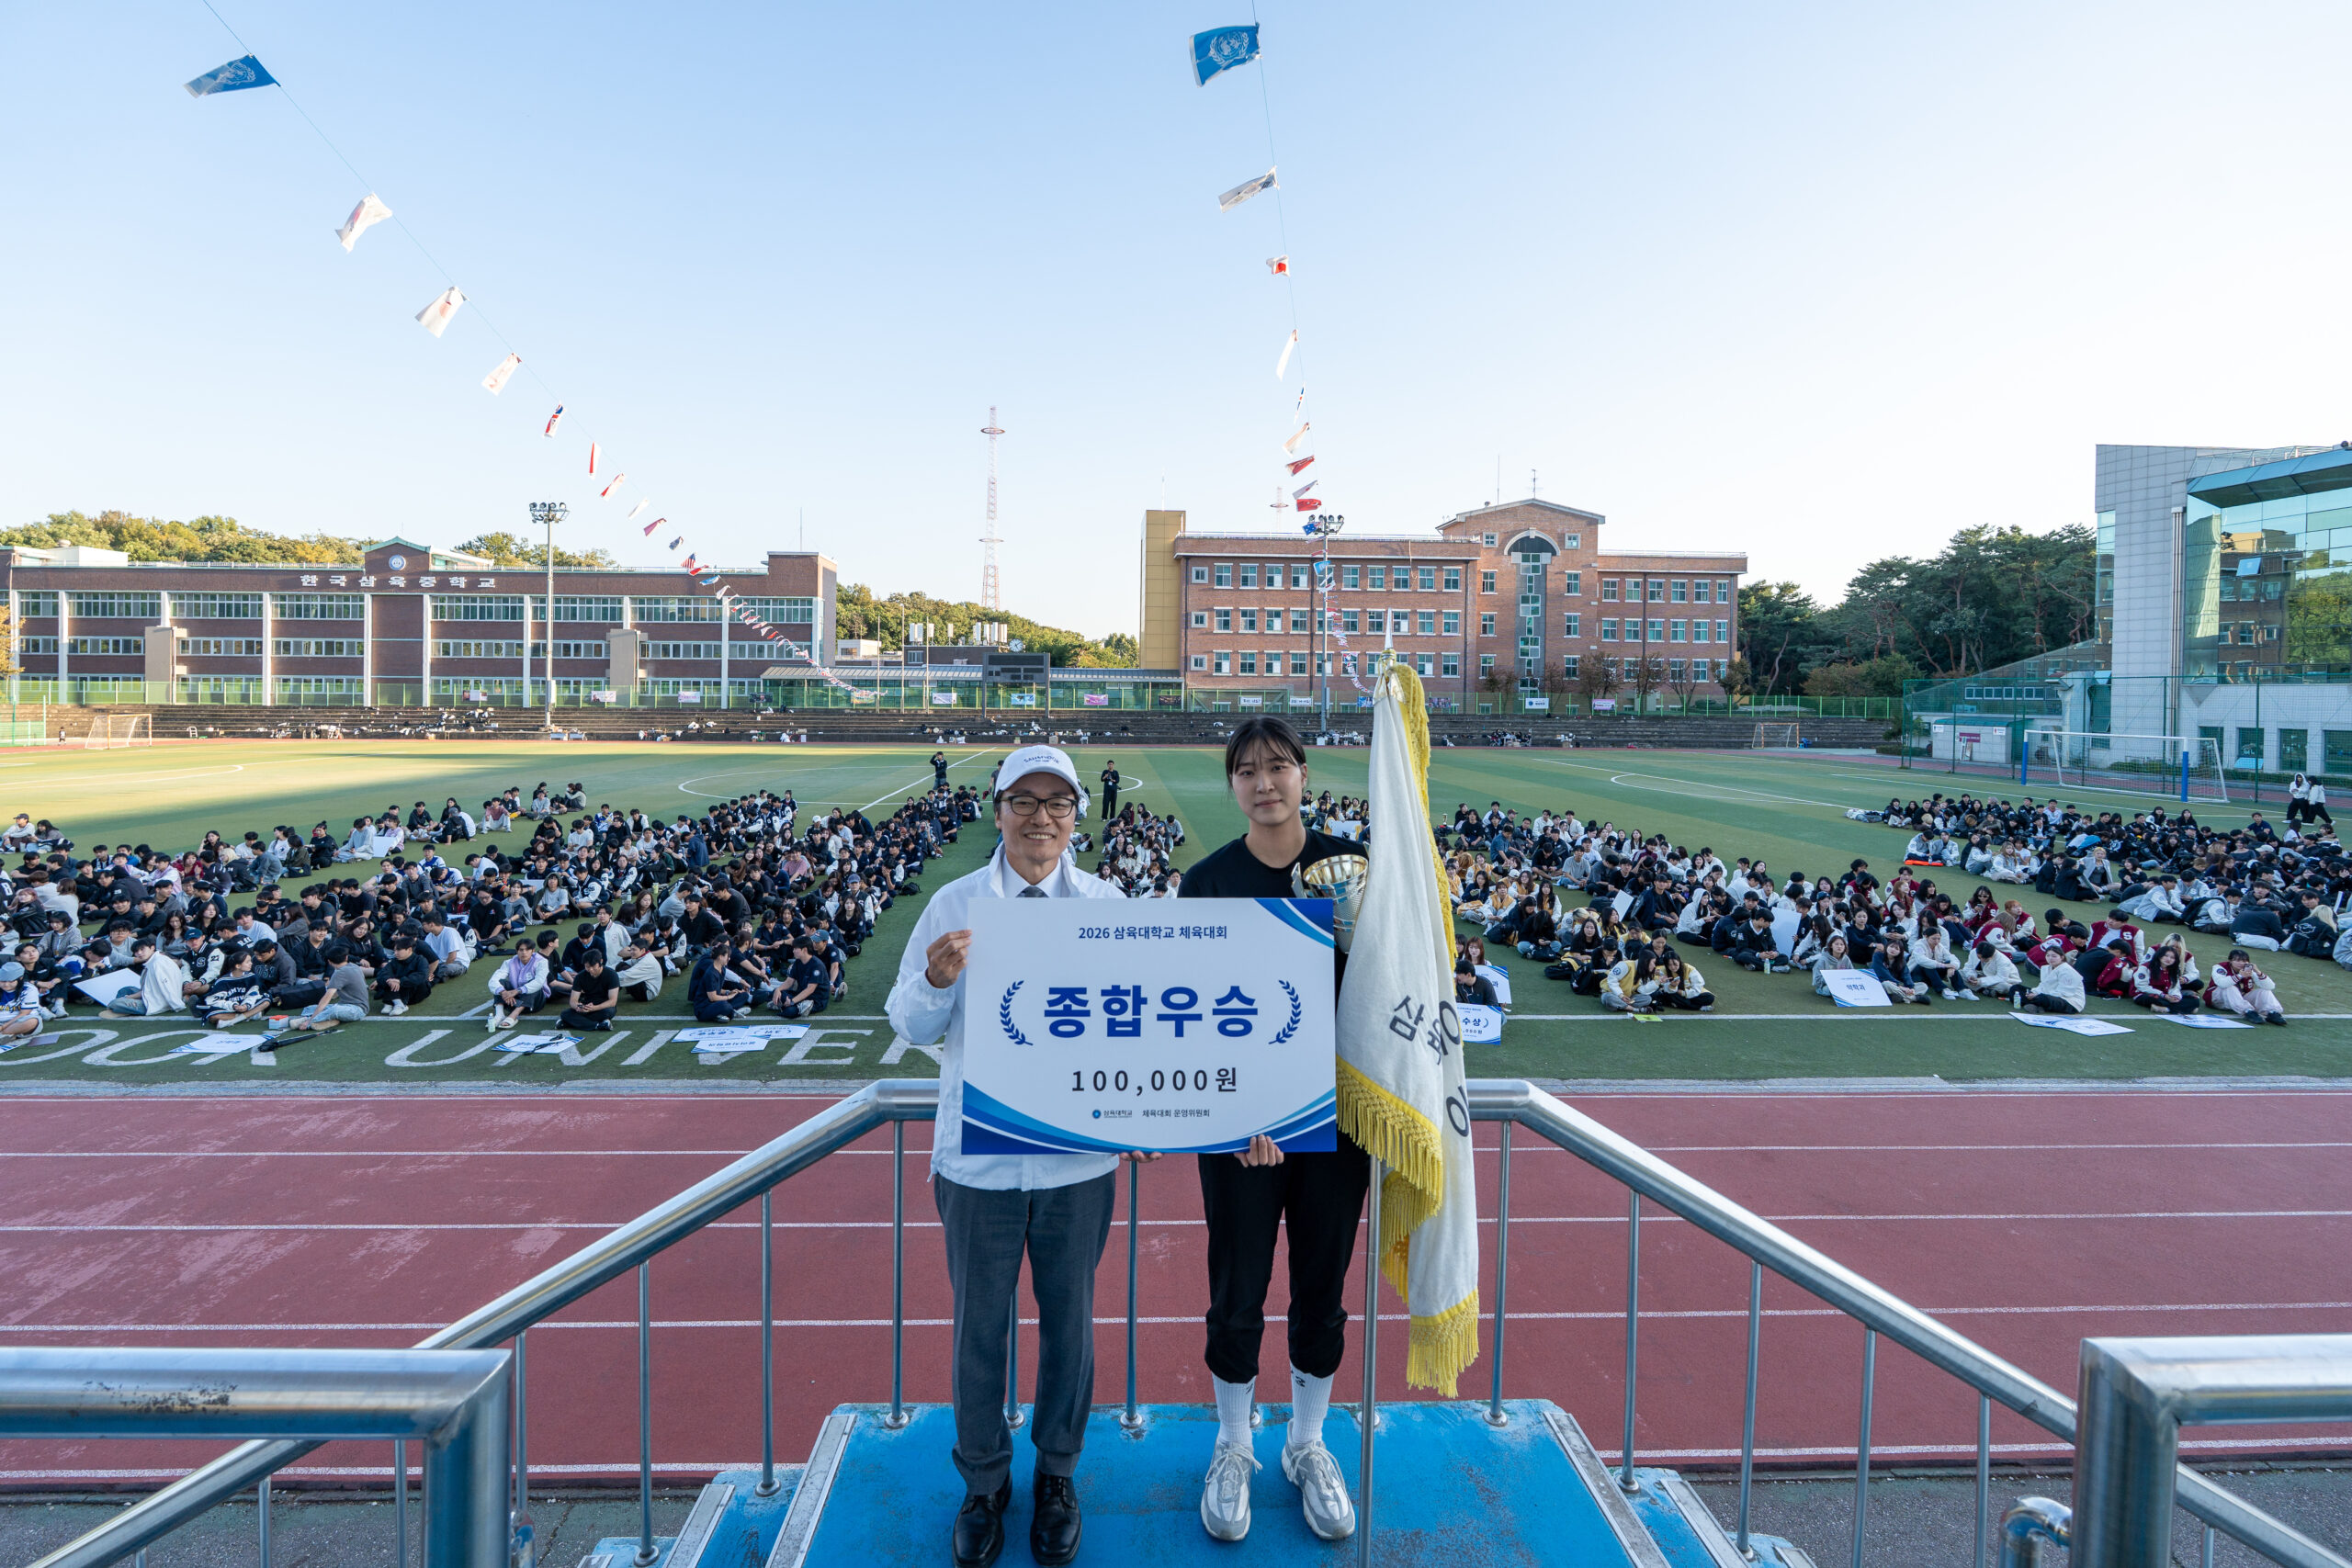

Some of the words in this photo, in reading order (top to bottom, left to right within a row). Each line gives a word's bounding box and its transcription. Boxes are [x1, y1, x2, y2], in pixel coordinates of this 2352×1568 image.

[300, 574, 496, 589] 한국삼육중학교
[1078, 926, 1111, 940] 2026
[1113, 925, 1175, 940] 삼육대학교
[1178, 925, 1227, 940] 체육대회
[2122, 931, 2132, 941] S
[1044, 984, 1259, 1039] 종합우승
[1071, 1066, 1238, 1097] 100,000원
[1142, 1109, 1171, 1118] 체육대회
[1173, 1109, 1211, 1118] 운영위원회
